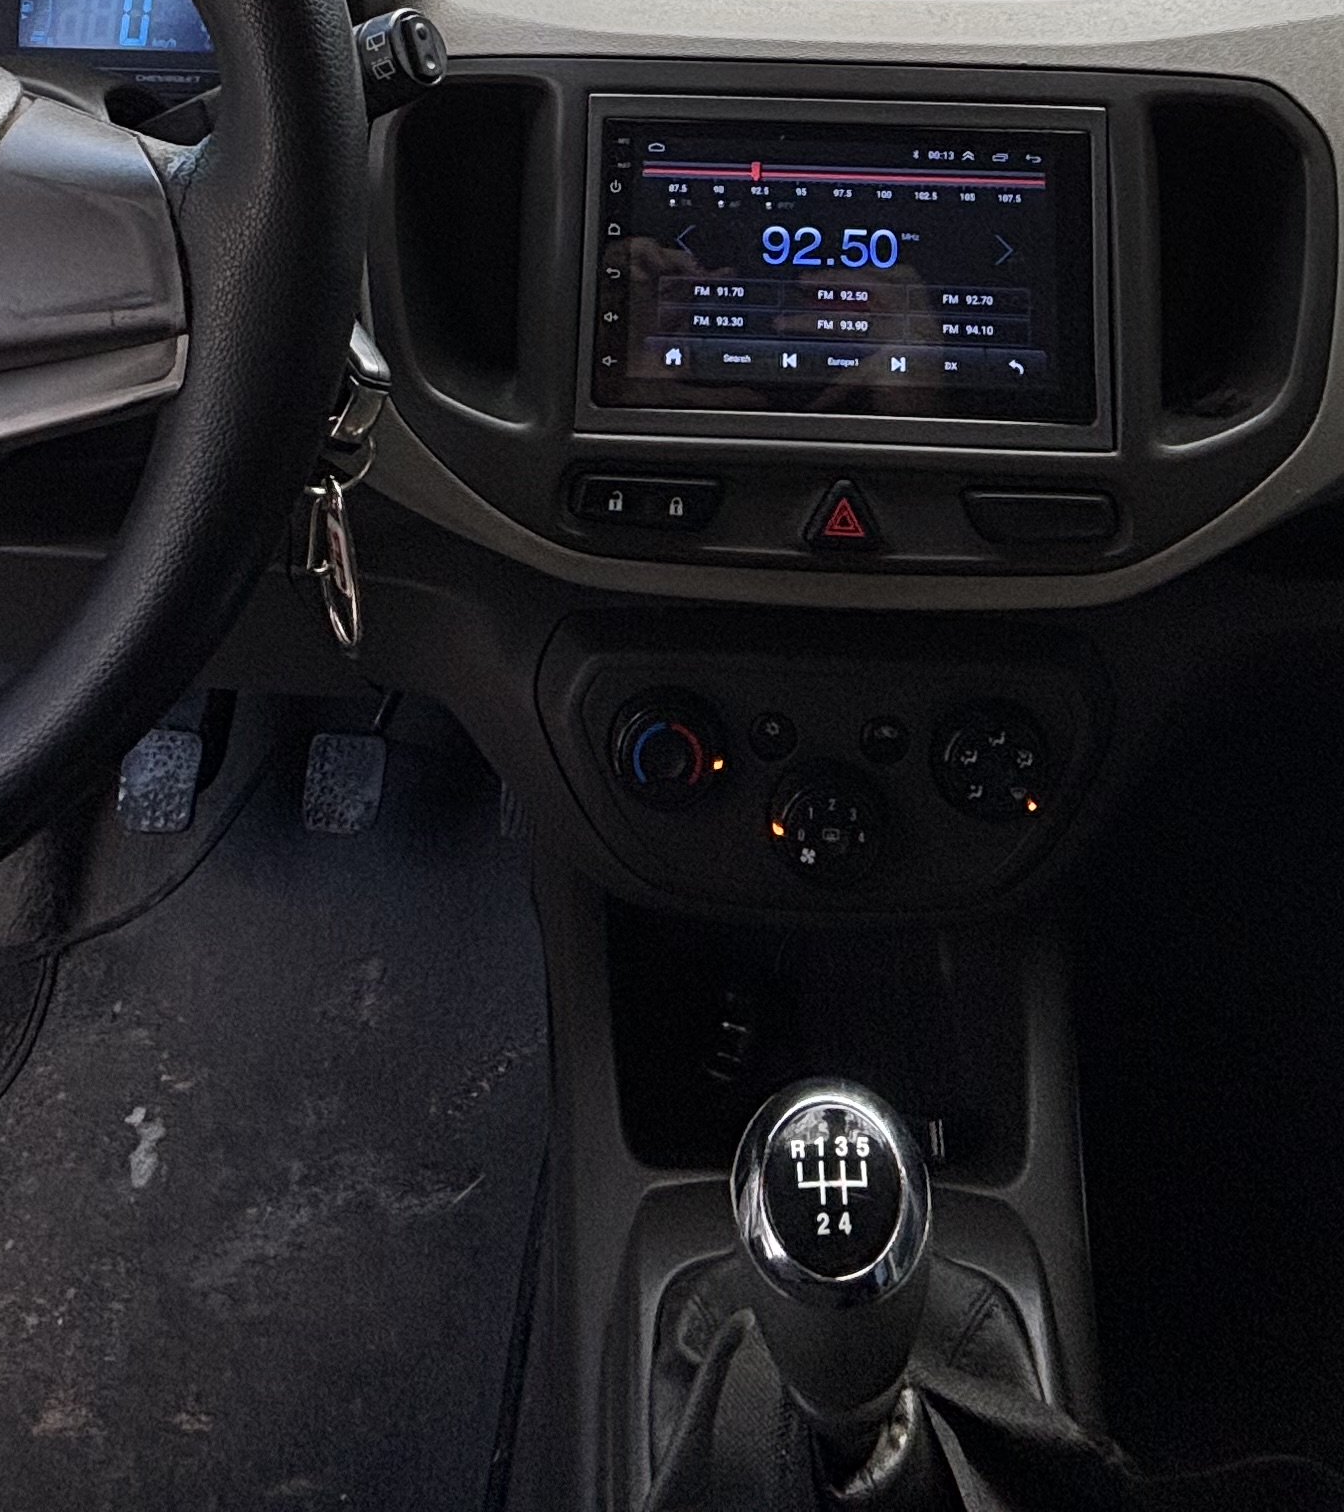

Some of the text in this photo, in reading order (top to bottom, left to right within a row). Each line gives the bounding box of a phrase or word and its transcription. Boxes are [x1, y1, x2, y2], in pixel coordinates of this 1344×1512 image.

[832, 189, 853, 199] 97.5
[762, 225, 898, 269] 92.50
[694, 286, 745, 298] FM 91.70
[817, 289, 869, 302] FM 92.50
[942, 294, 994, 306] FM 92.70
[693, 315, 744, 327] FM 93.30
[817, 319, 869, 331] FM 93.90
[942, 324, 994, 336] FM 94.10
[790, 1136, 870, 1159] R 1 3 5
[816, 1211, 853, 1236] 2 4
